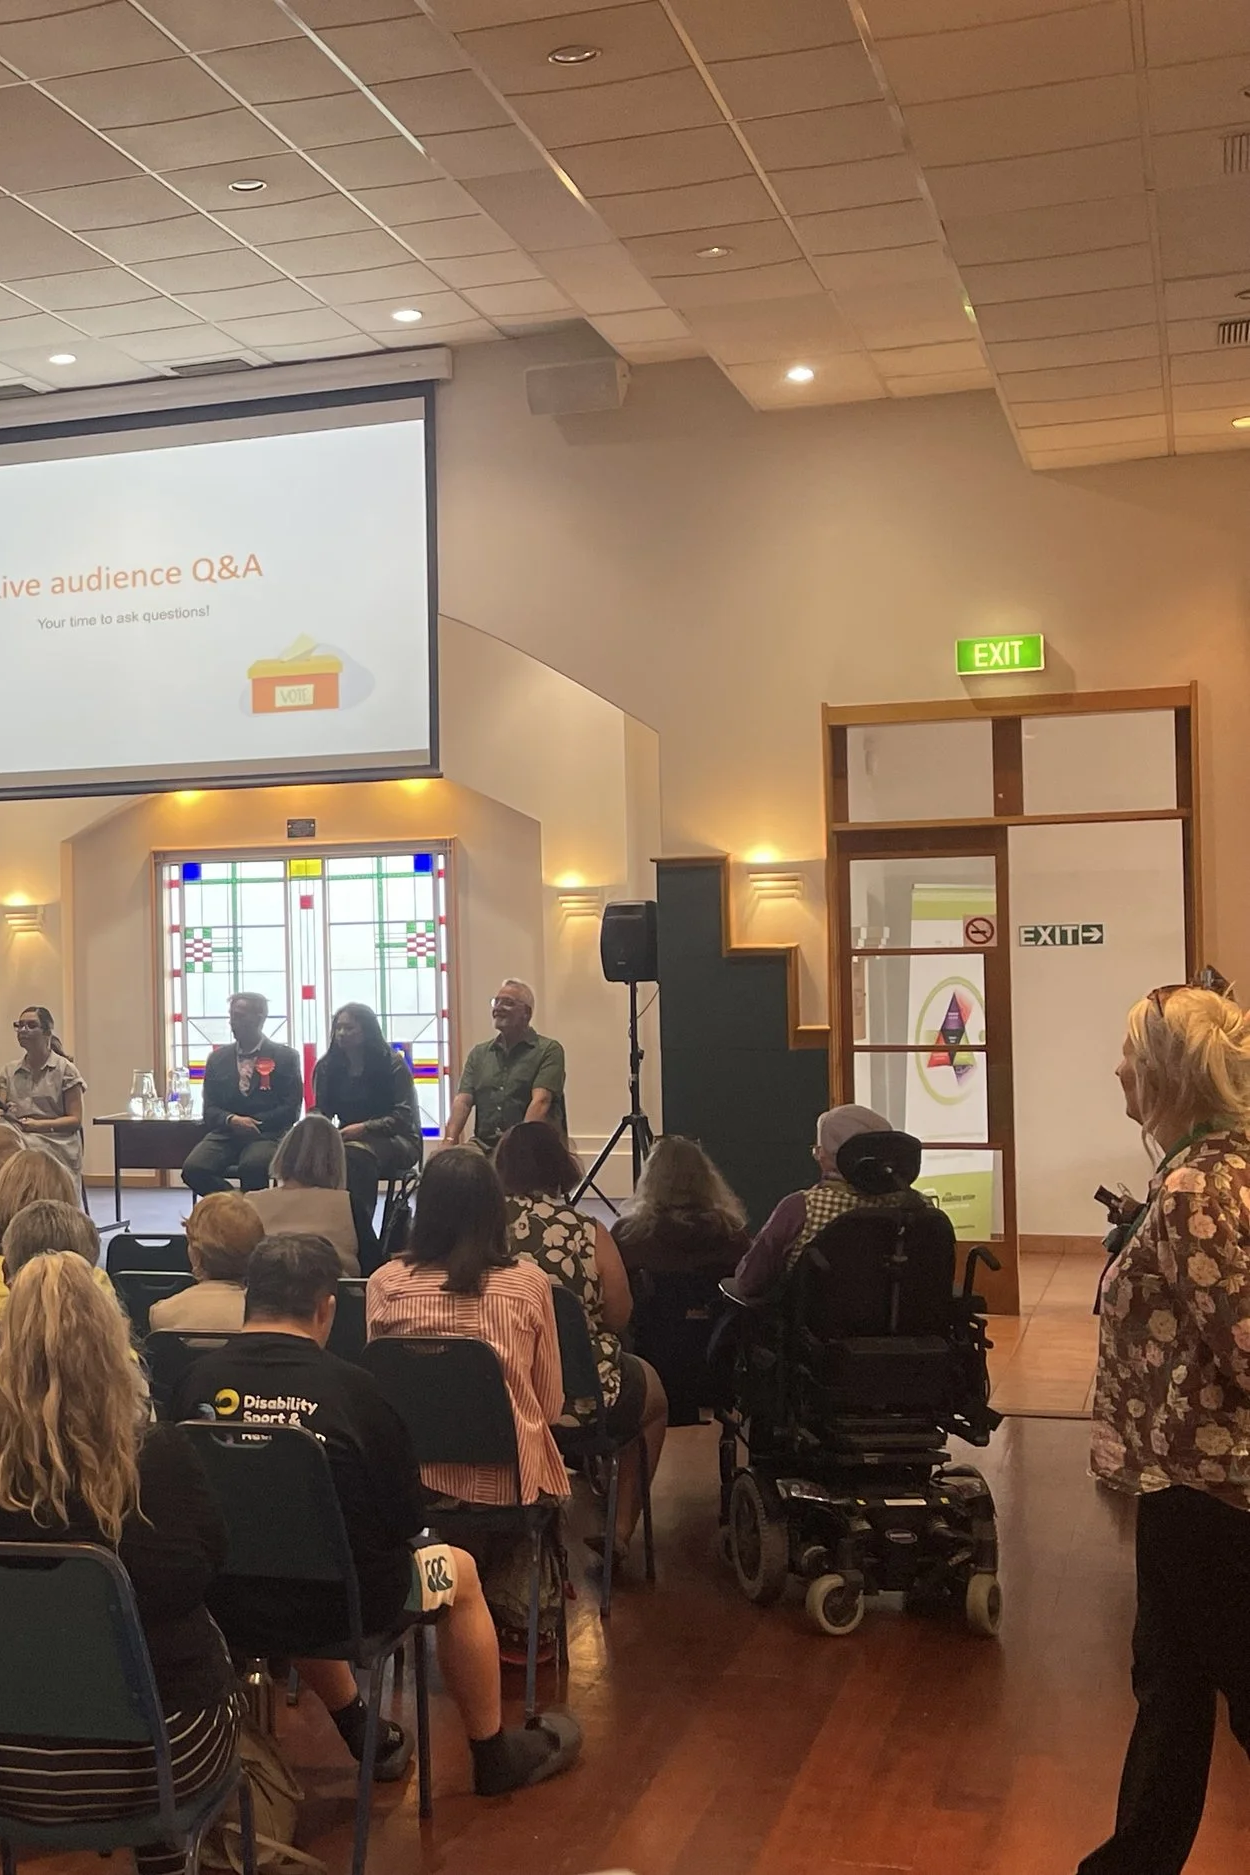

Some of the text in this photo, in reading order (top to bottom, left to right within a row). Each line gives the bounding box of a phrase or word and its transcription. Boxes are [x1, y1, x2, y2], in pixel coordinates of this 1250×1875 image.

[50, 565, 182, 595] audience
[192, 553, 263, 584] Q&A
[38, 604, 210, 630] Your time to ask questions!
[974, 640, 1024, 667] EXIT
[279, 687, 311, 704] VOTE
[1019, 925, 1079, 946] EXIT
[243, 1394, 319, 1416] Disability
[243, 1410, 302, 1427] Sport &
